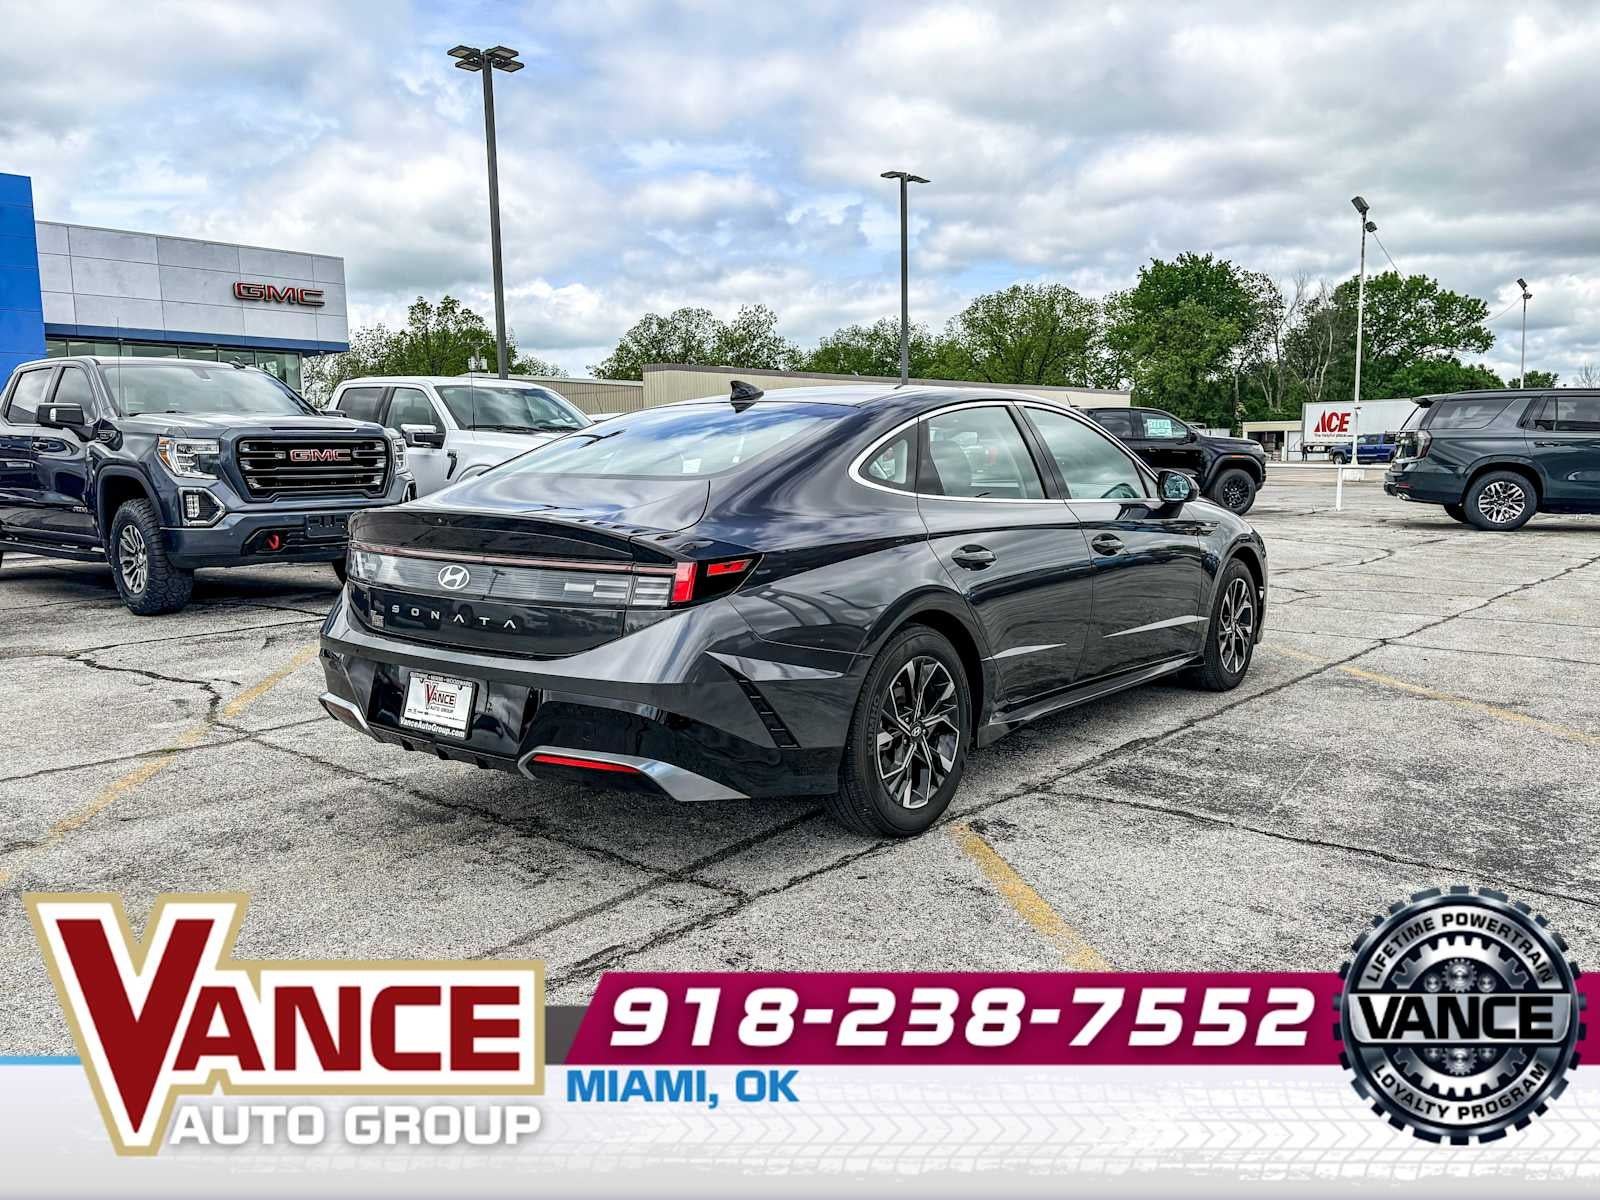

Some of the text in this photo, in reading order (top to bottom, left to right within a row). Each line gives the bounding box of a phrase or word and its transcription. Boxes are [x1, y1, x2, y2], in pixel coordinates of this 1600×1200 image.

[232, 282, 325, 306] GMC
[1314, 409, 1351, 432] ACE
[290, 449, 351, 461] GMC
[391, 604, 516, 629] SONATA
[425, 682, 455, 705] VANCE
[400, 717, 466, 738] VanceAutoGroup.com
